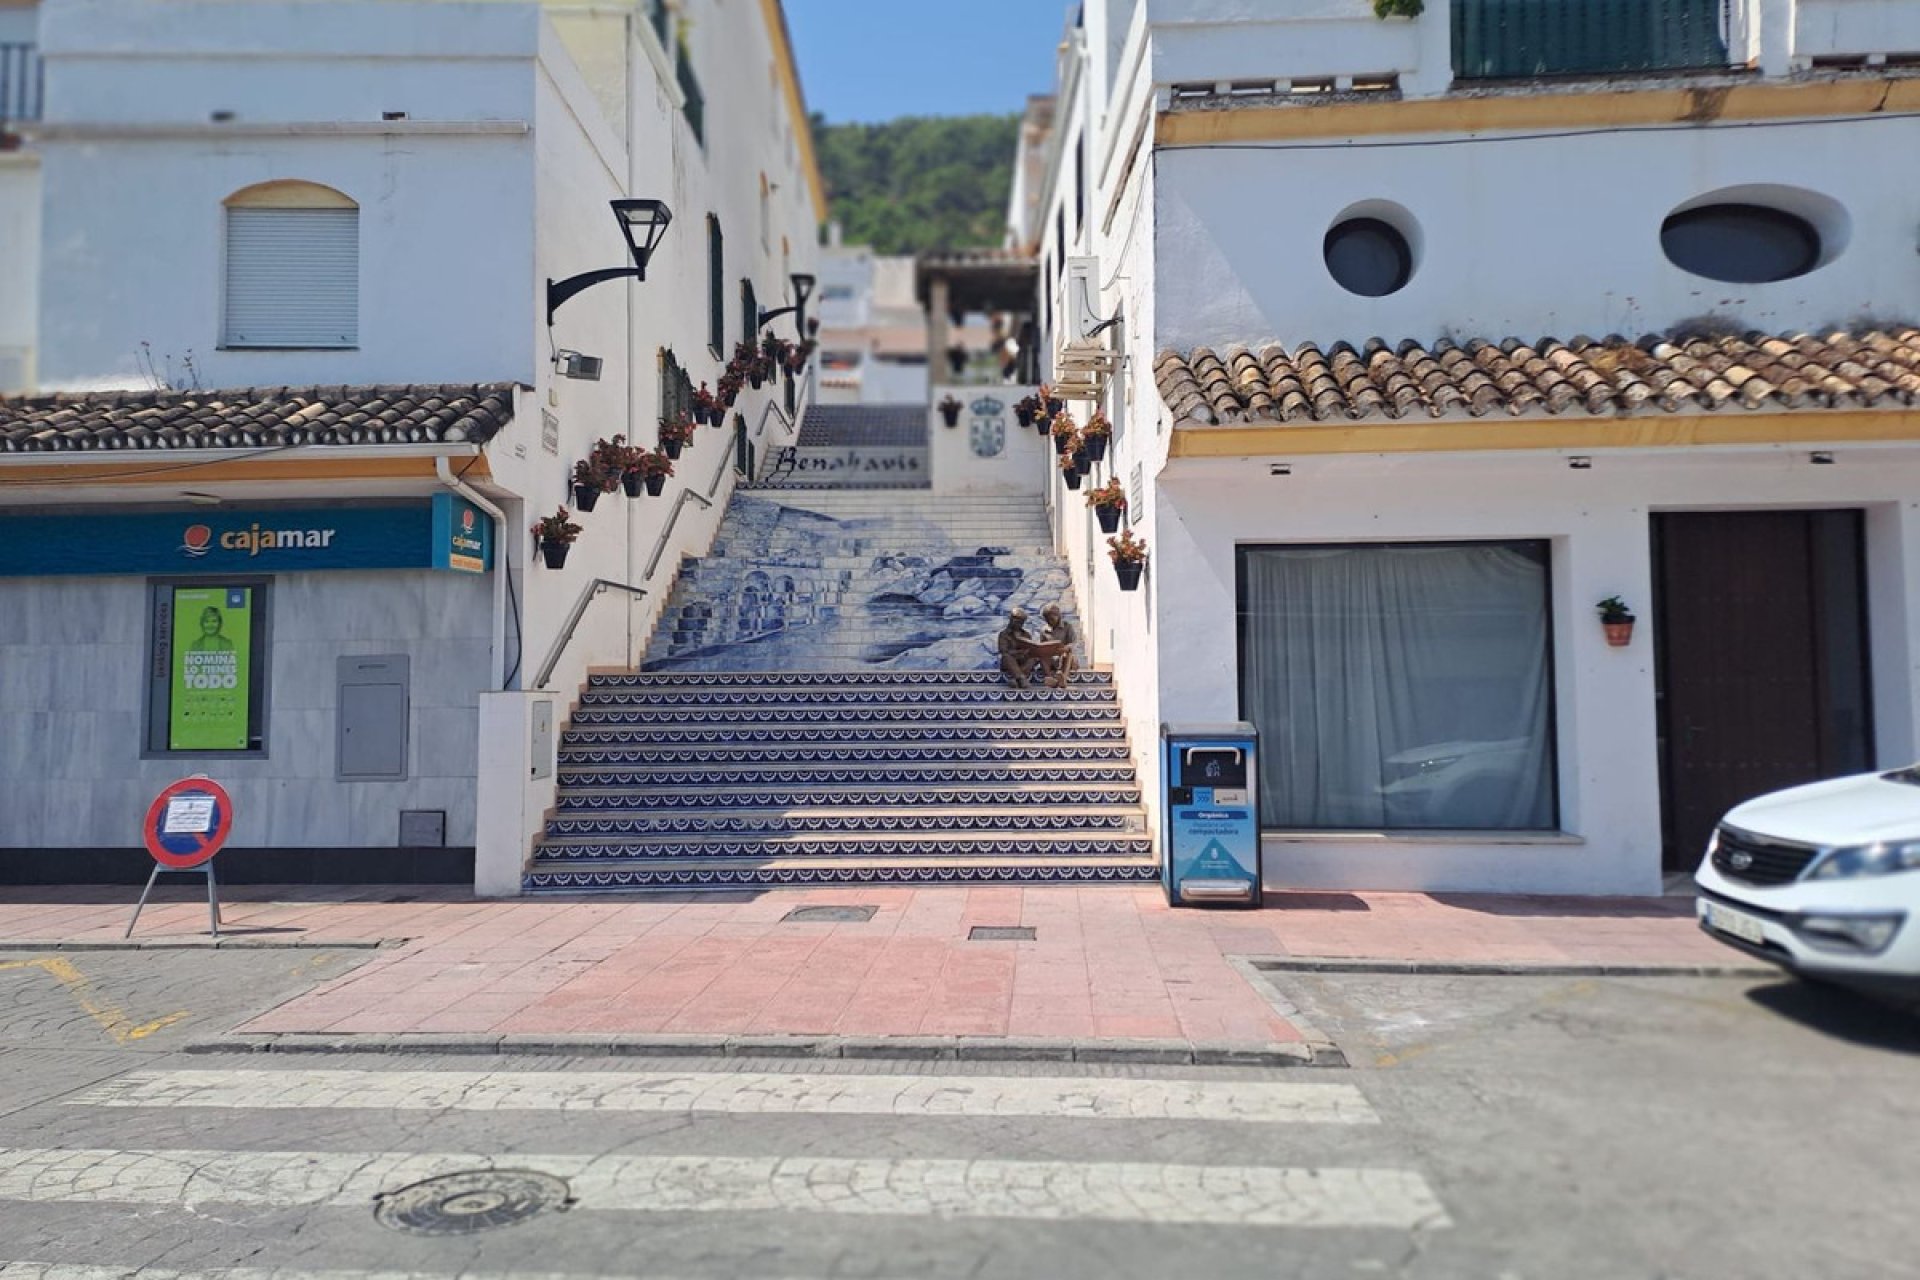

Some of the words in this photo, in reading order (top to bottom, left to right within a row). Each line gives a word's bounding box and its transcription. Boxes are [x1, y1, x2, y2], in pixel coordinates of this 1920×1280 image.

[220, 522, 336, 556] cajamar
[452, 534, 482, 550] cajamar
[184, 665, 198, 674] LO
[184, 675, 238, 689] TODO
